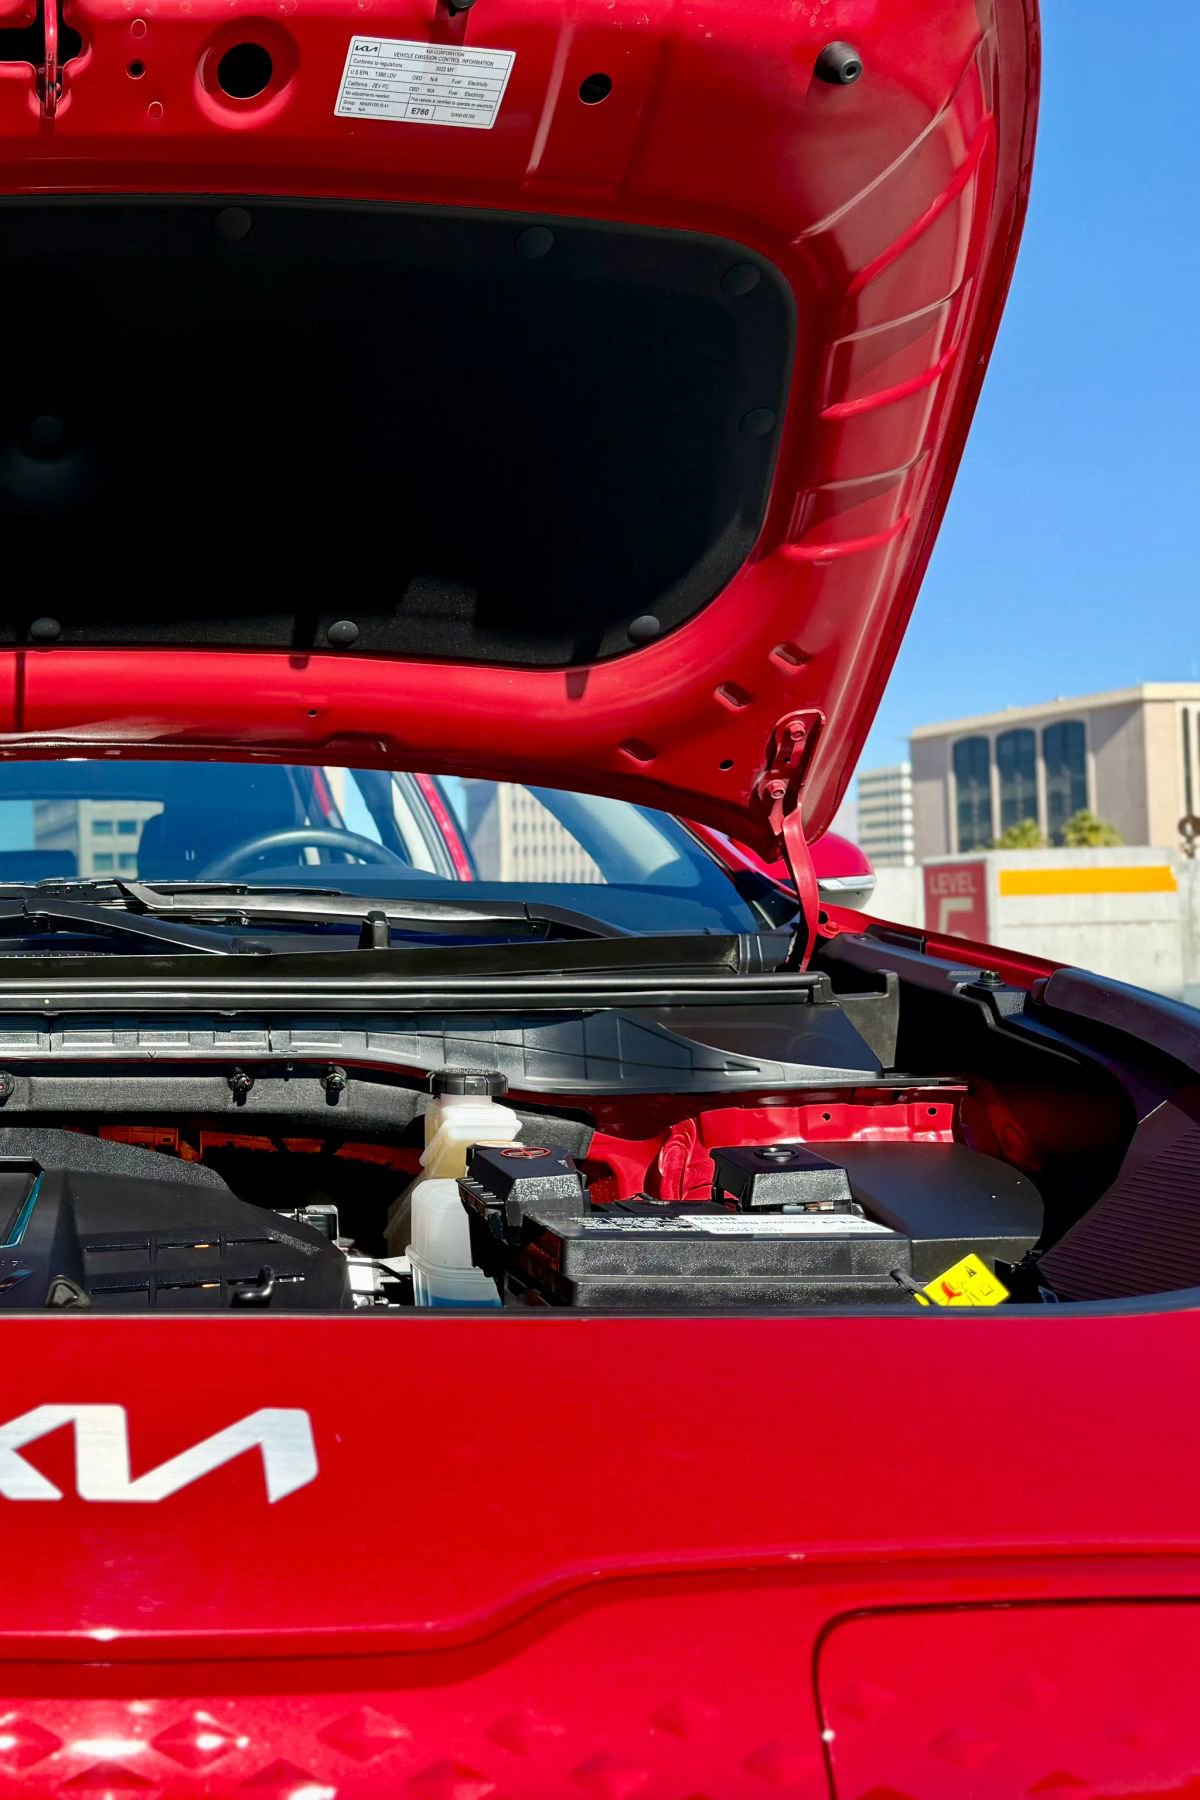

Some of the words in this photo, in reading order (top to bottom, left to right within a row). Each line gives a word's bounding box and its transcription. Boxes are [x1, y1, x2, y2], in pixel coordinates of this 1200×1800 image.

[355, 44, 378, 53] KIA
[380, 60, 403, 68] regulations
[930, 872, 976, 894] LEVEL
